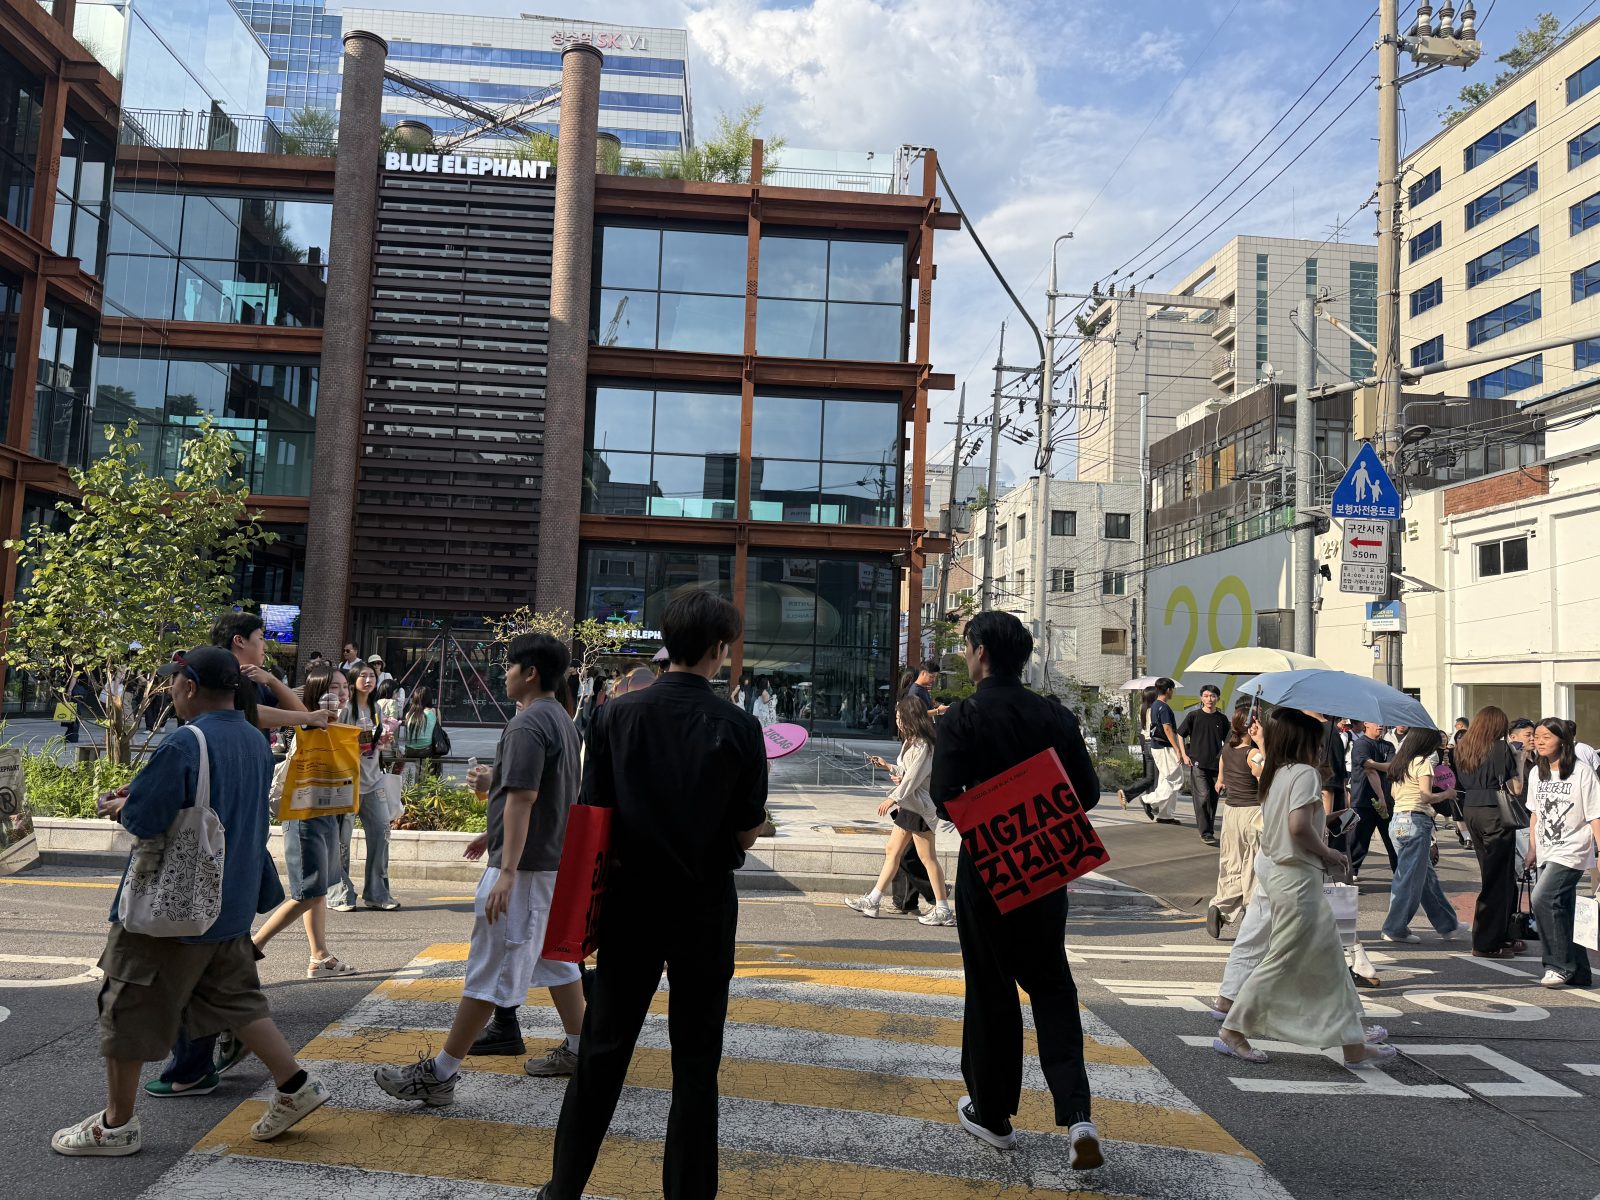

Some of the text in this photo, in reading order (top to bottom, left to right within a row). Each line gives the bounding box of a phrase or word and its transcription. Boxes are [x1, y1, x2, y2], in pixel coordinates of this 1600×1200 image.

[597, 32, 621, 49] SK
[626, 34, 647, 50] V1
[385, 152, 550, 179] BLUE ELEPHANT
[1335, 504, 1396, 517] 보행자전용도로
[1348, 524, 1385, 535] 구간시작
[1352, 550, 1378, 559] 550m
[632, 630, 663, 640] ELEPH
[764, 728, 793, 750] ZIGZAG
[962, 782, 1079, 858] ZIGZAG
[976, 813, 1107, 900] 직잭팟
